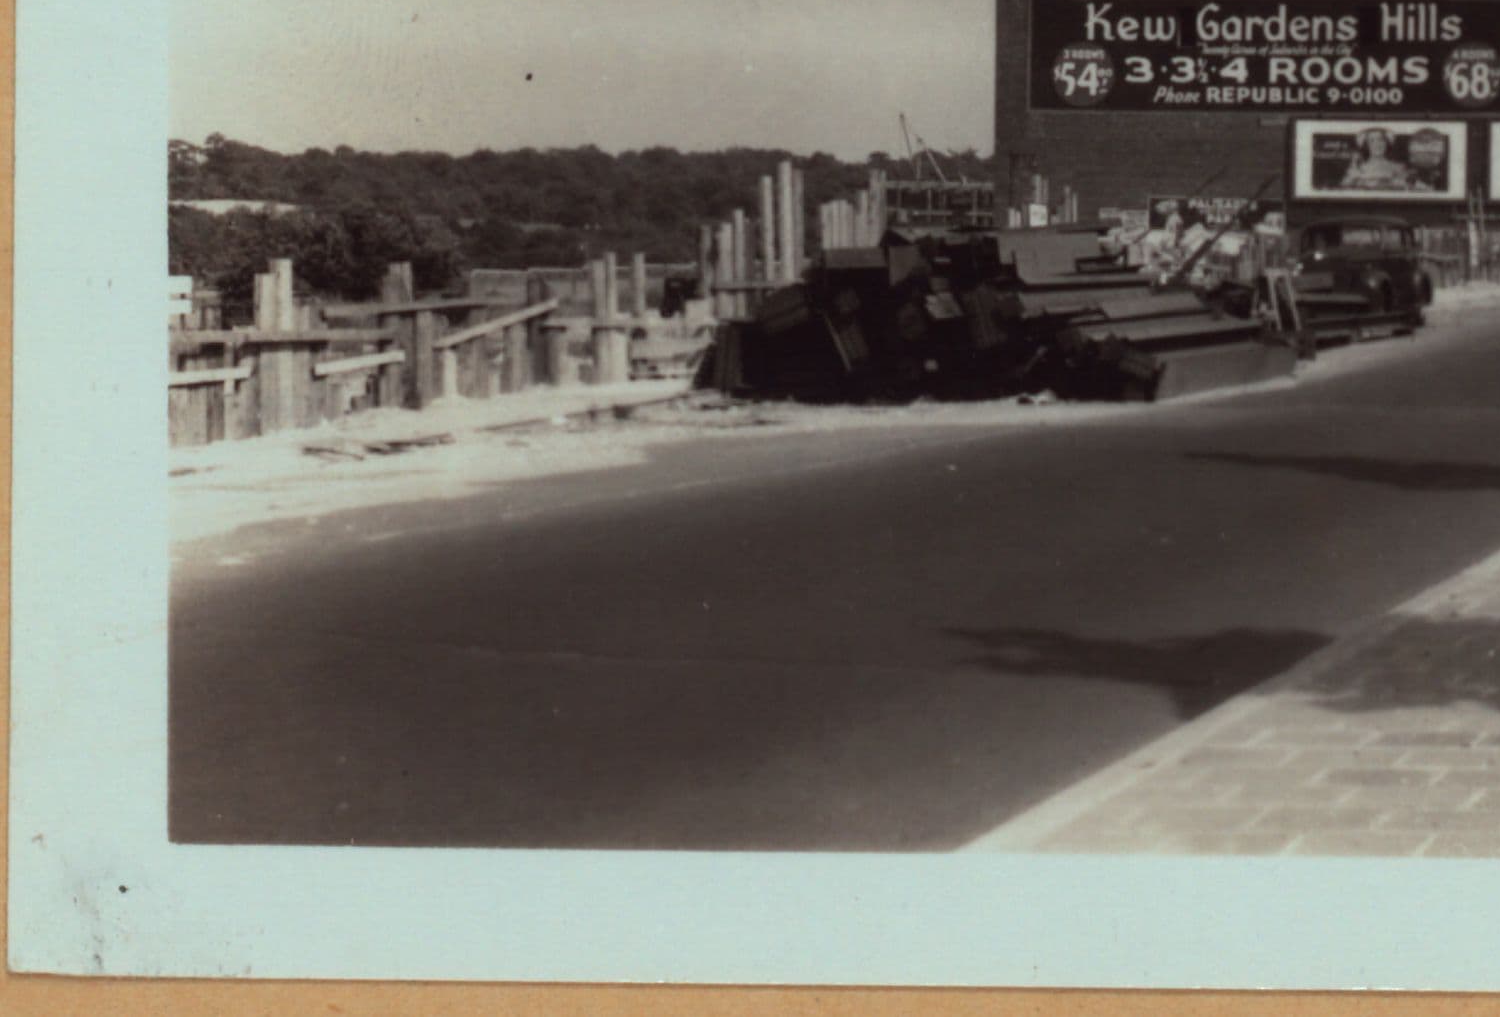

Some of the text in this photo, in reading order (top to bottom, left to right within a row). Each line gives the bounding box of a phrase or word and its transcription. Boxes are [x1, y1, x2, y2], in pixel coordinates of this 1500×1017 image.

[1084, 2, 1463, 42] Kew Gardens Hills
[1072, 49, 1105, 60] ROOMS
[1268, 56, 1430, 85] ROOMS
[1153, 85, 1404, 105] Phone REPUBLIC 9-0100
